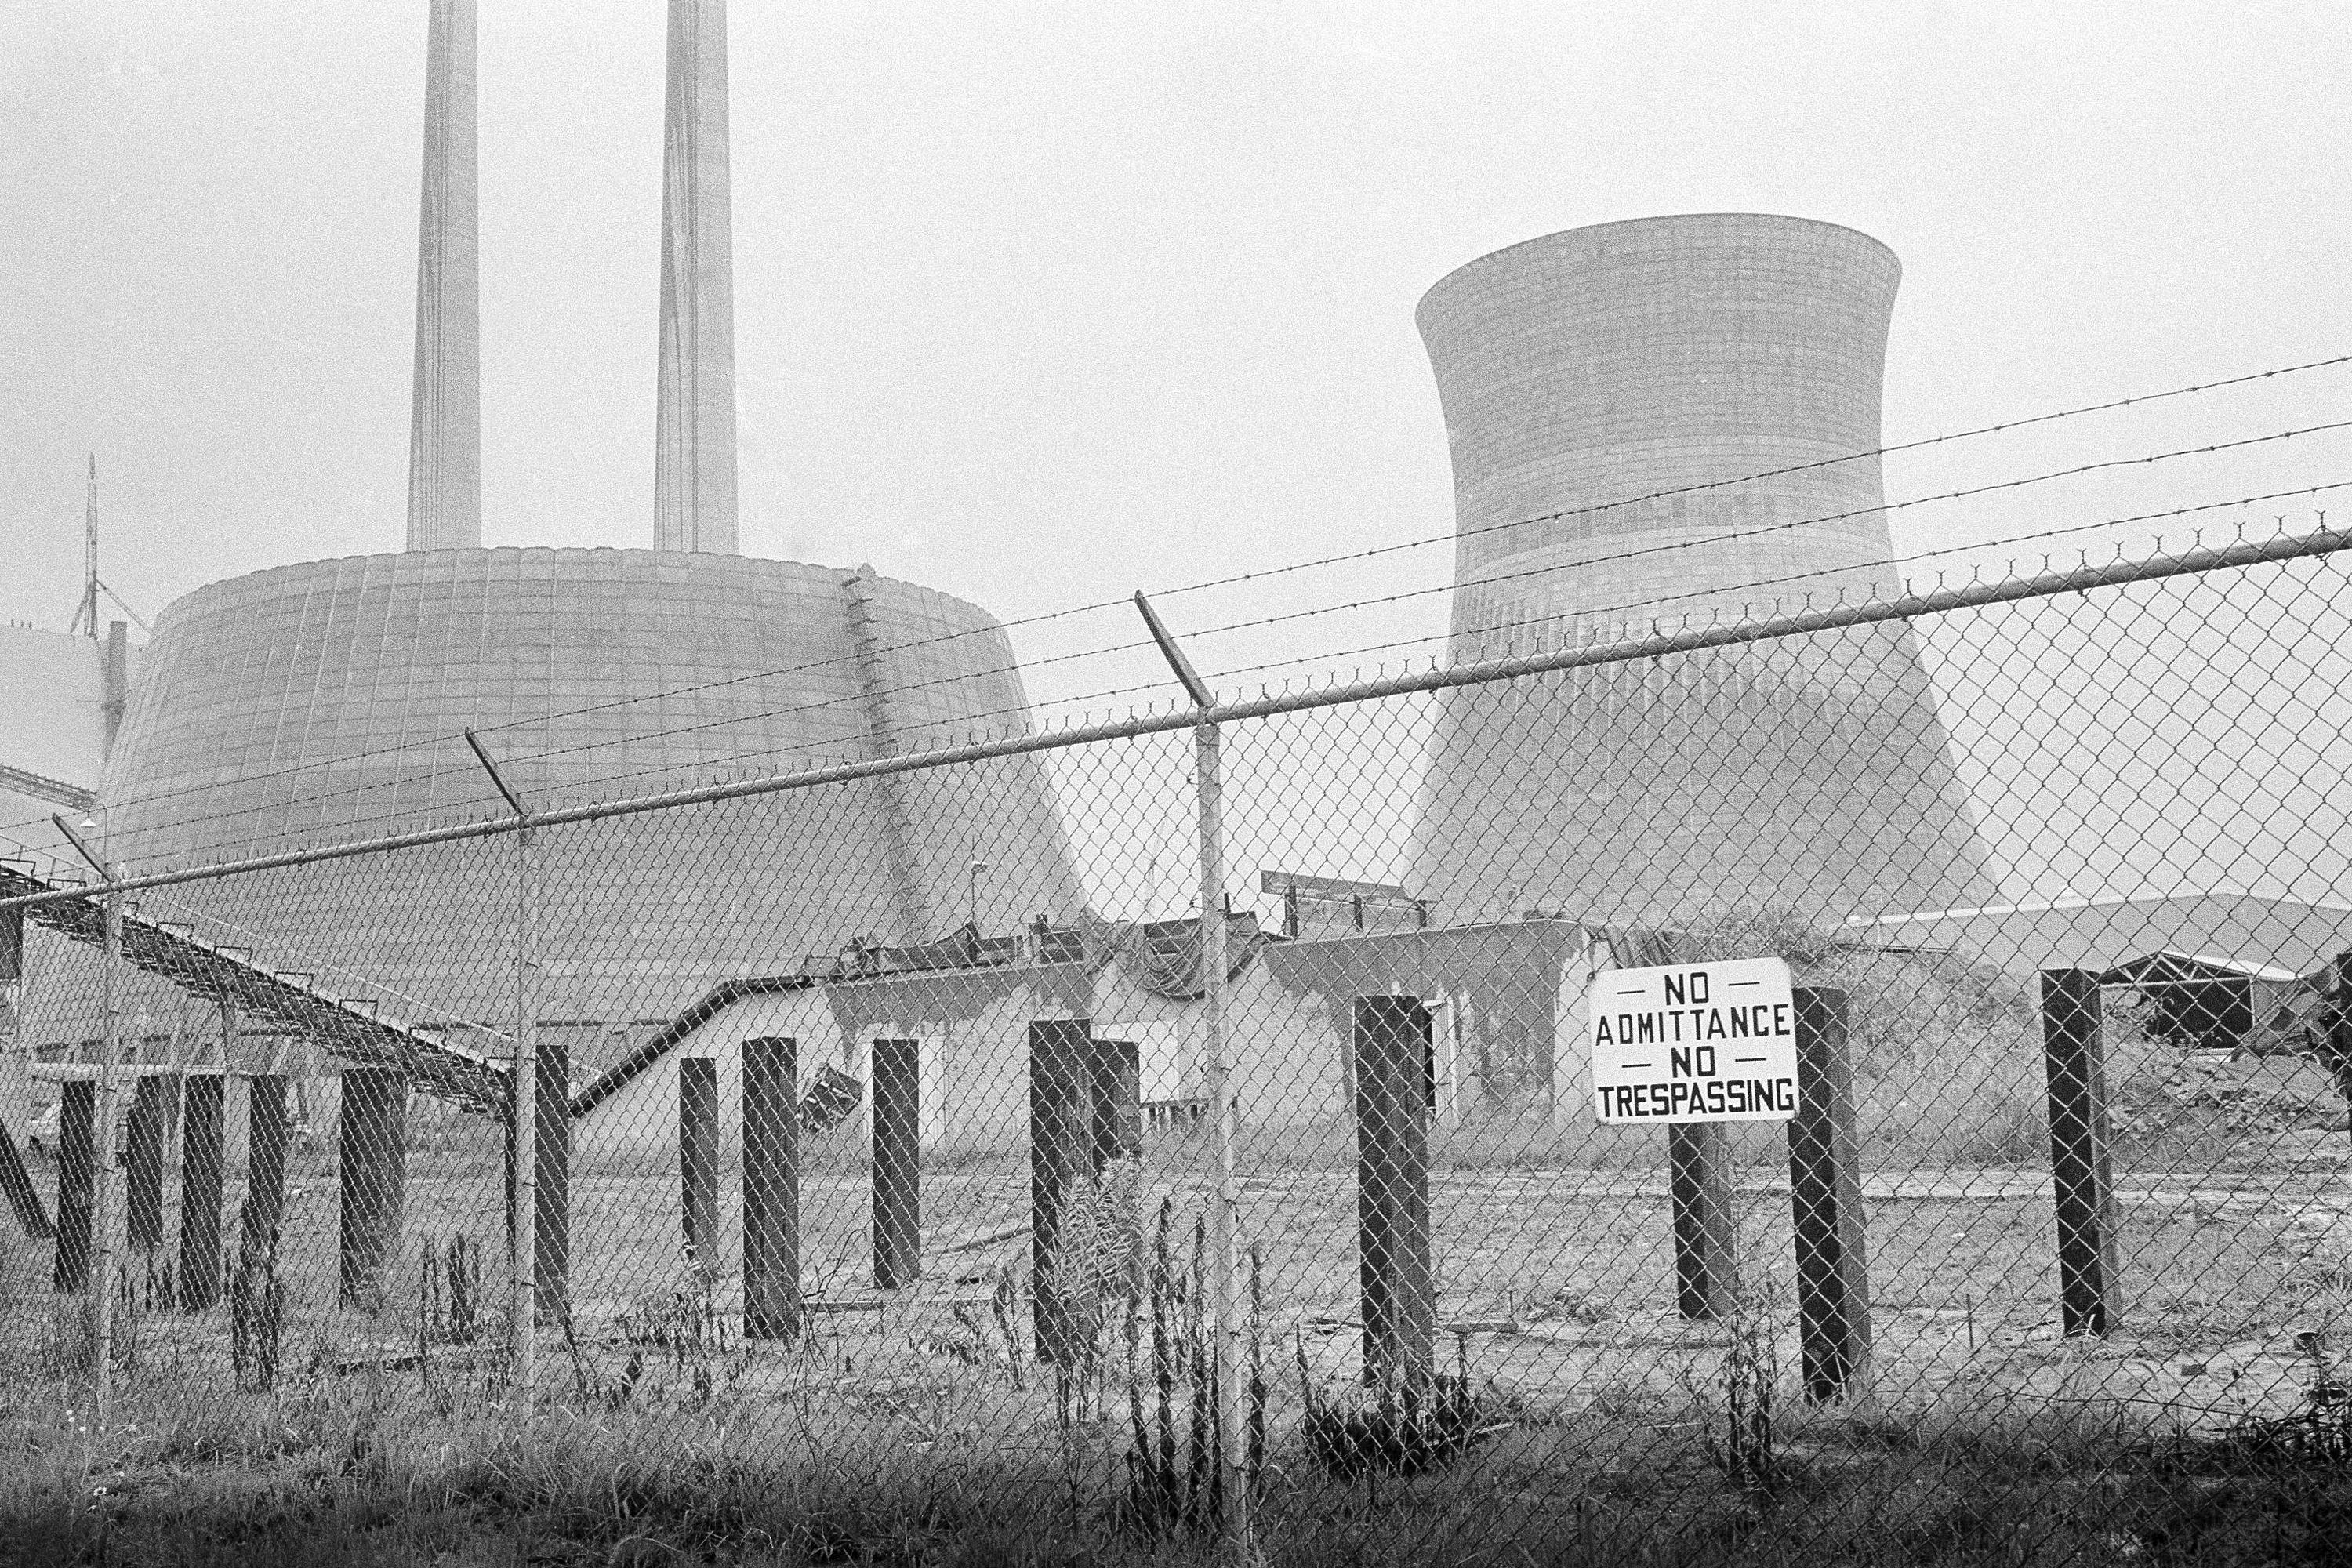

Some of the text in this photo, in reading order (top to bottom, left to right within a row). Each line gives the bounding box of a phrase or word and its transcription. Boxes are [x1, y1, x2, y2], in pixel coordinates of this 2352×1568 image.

[1664, 971, 1709, 1006] NO
[1595, 1004, 1791, 1046] ADMITTANCE
[1671, 1045, 1716, 1078] NO
[1598, 1078, 1795, 1117] TRESPASSING
